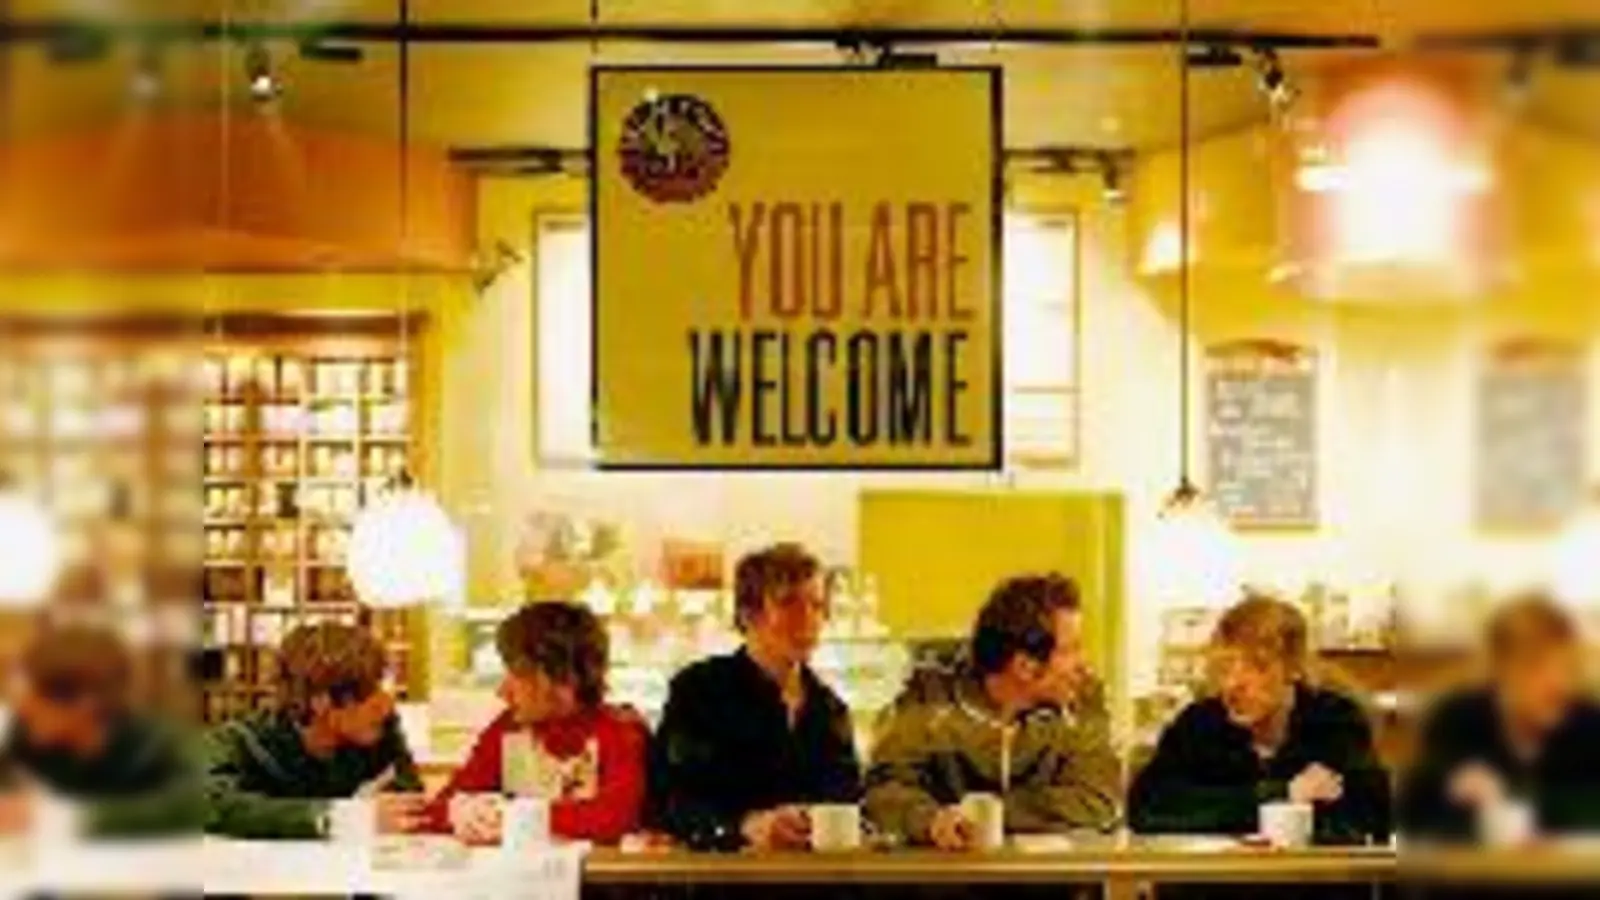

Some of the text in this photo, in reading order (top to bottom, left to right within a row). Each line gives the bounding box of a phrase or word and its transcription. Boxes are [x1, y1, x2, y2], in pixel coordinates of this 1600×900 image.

[728, 202, 973, 322] YOU ARE
[688, 329, 971, 447] WELCOME
